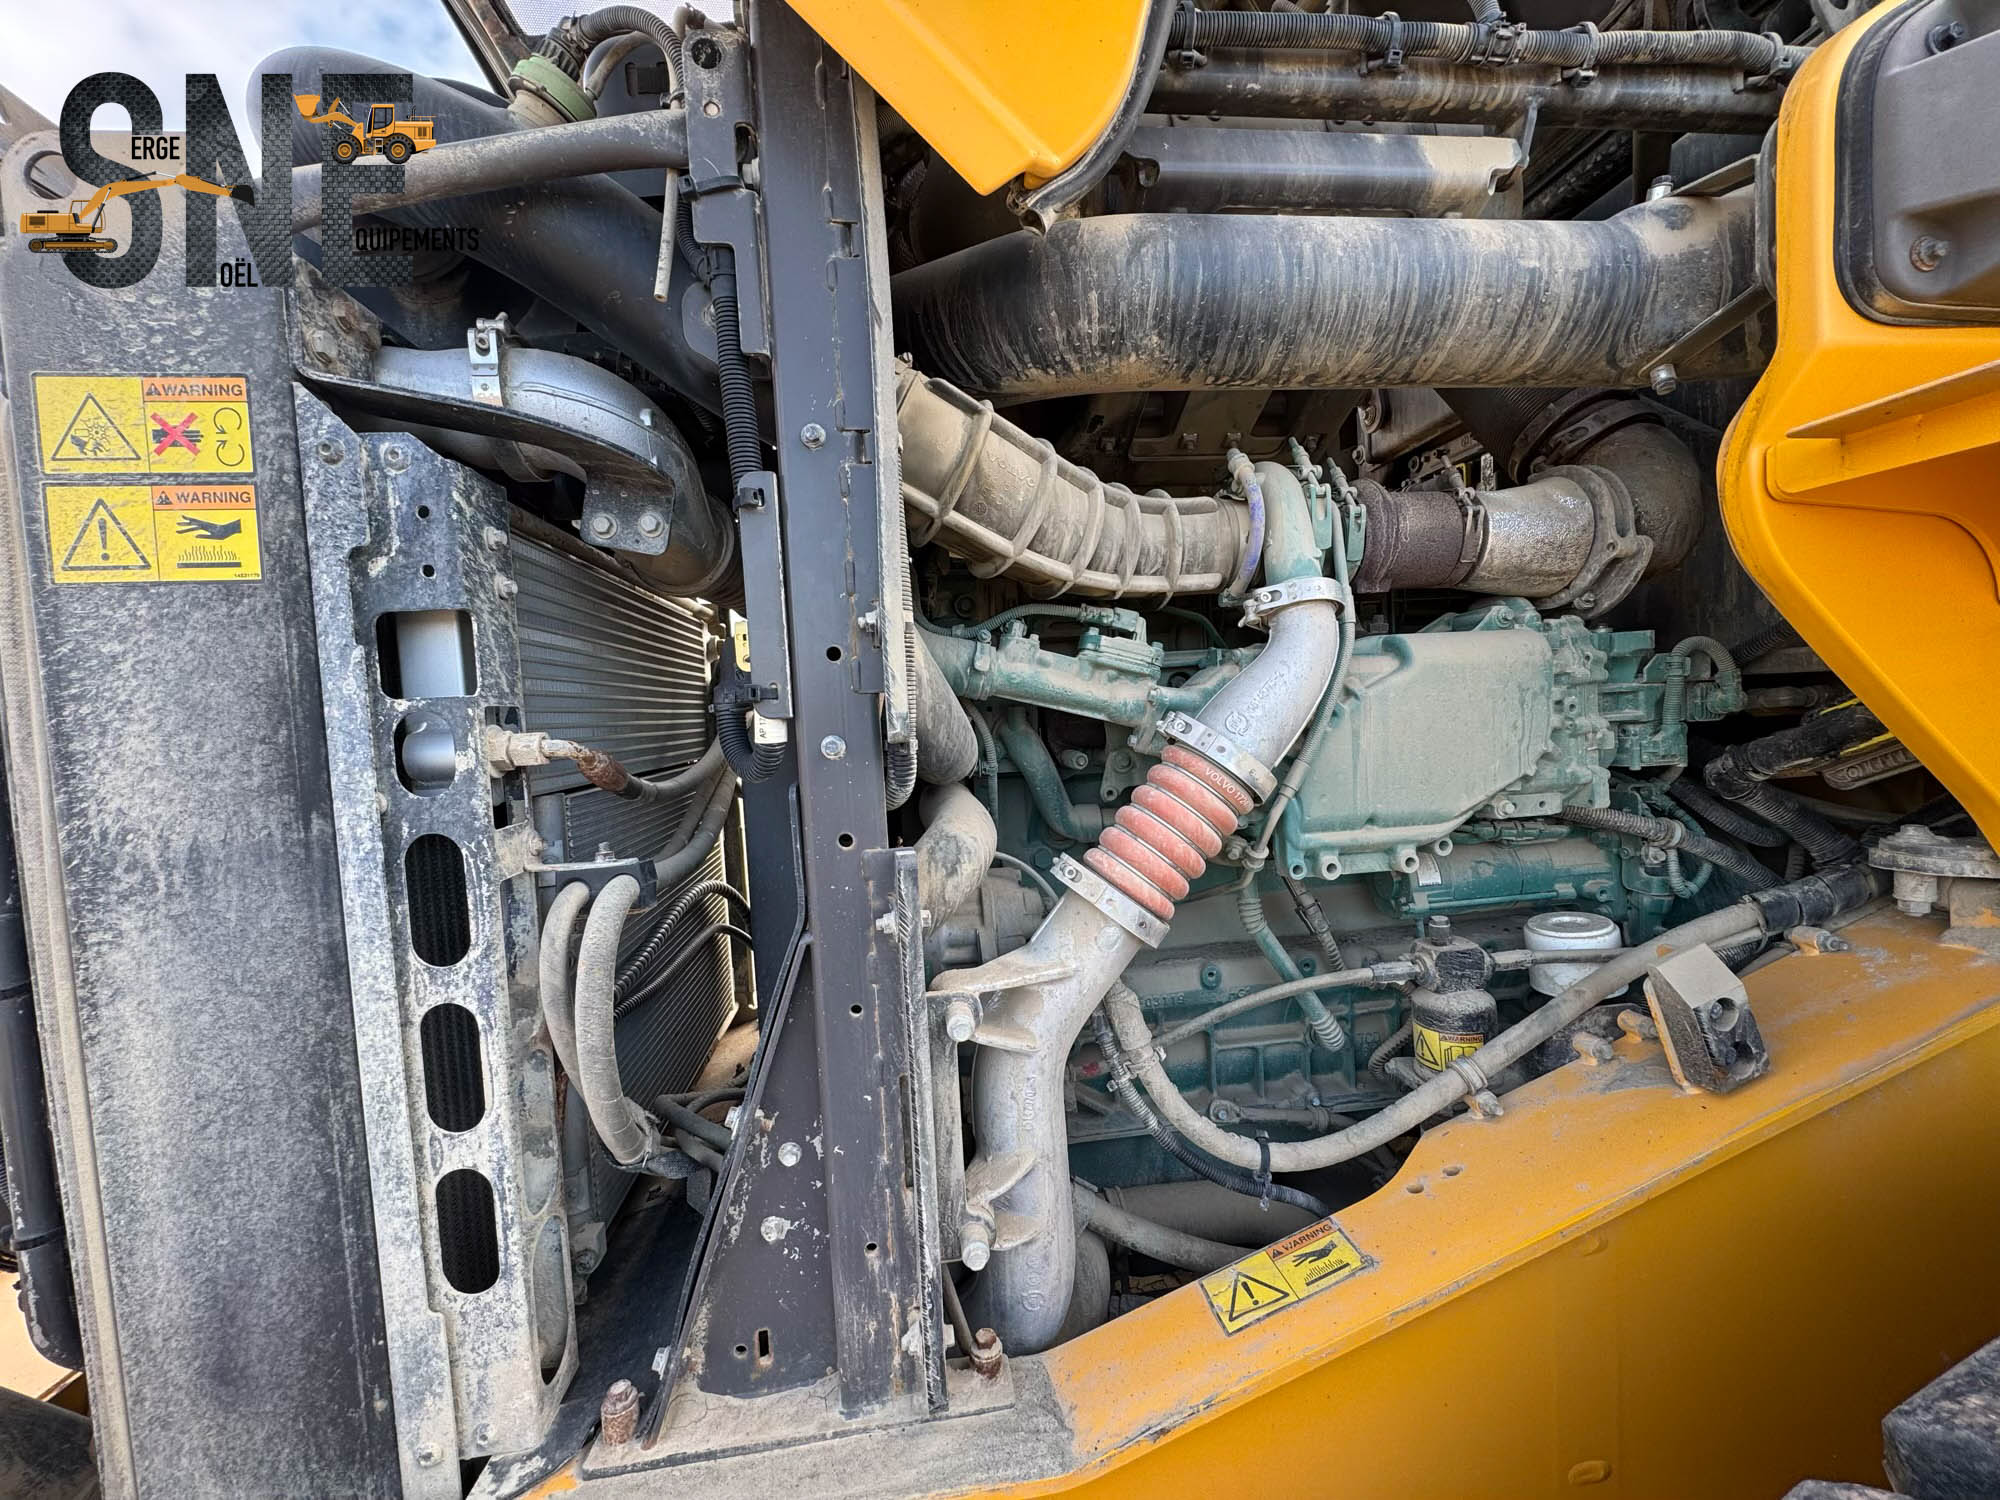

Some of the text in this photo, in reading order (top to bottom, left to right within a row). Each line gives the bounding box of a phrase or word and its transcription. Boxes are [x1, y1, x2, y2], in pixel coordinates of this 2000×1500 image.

[162, 383, 243, 397] WARNING
[176, 491, 251, 504] WARNING
[1205, 766, 1236, 795] VOLVO
[1448, 1034, 1484, 1043] WARNING
[1282, 1223, 1332, 1252] WARNING
